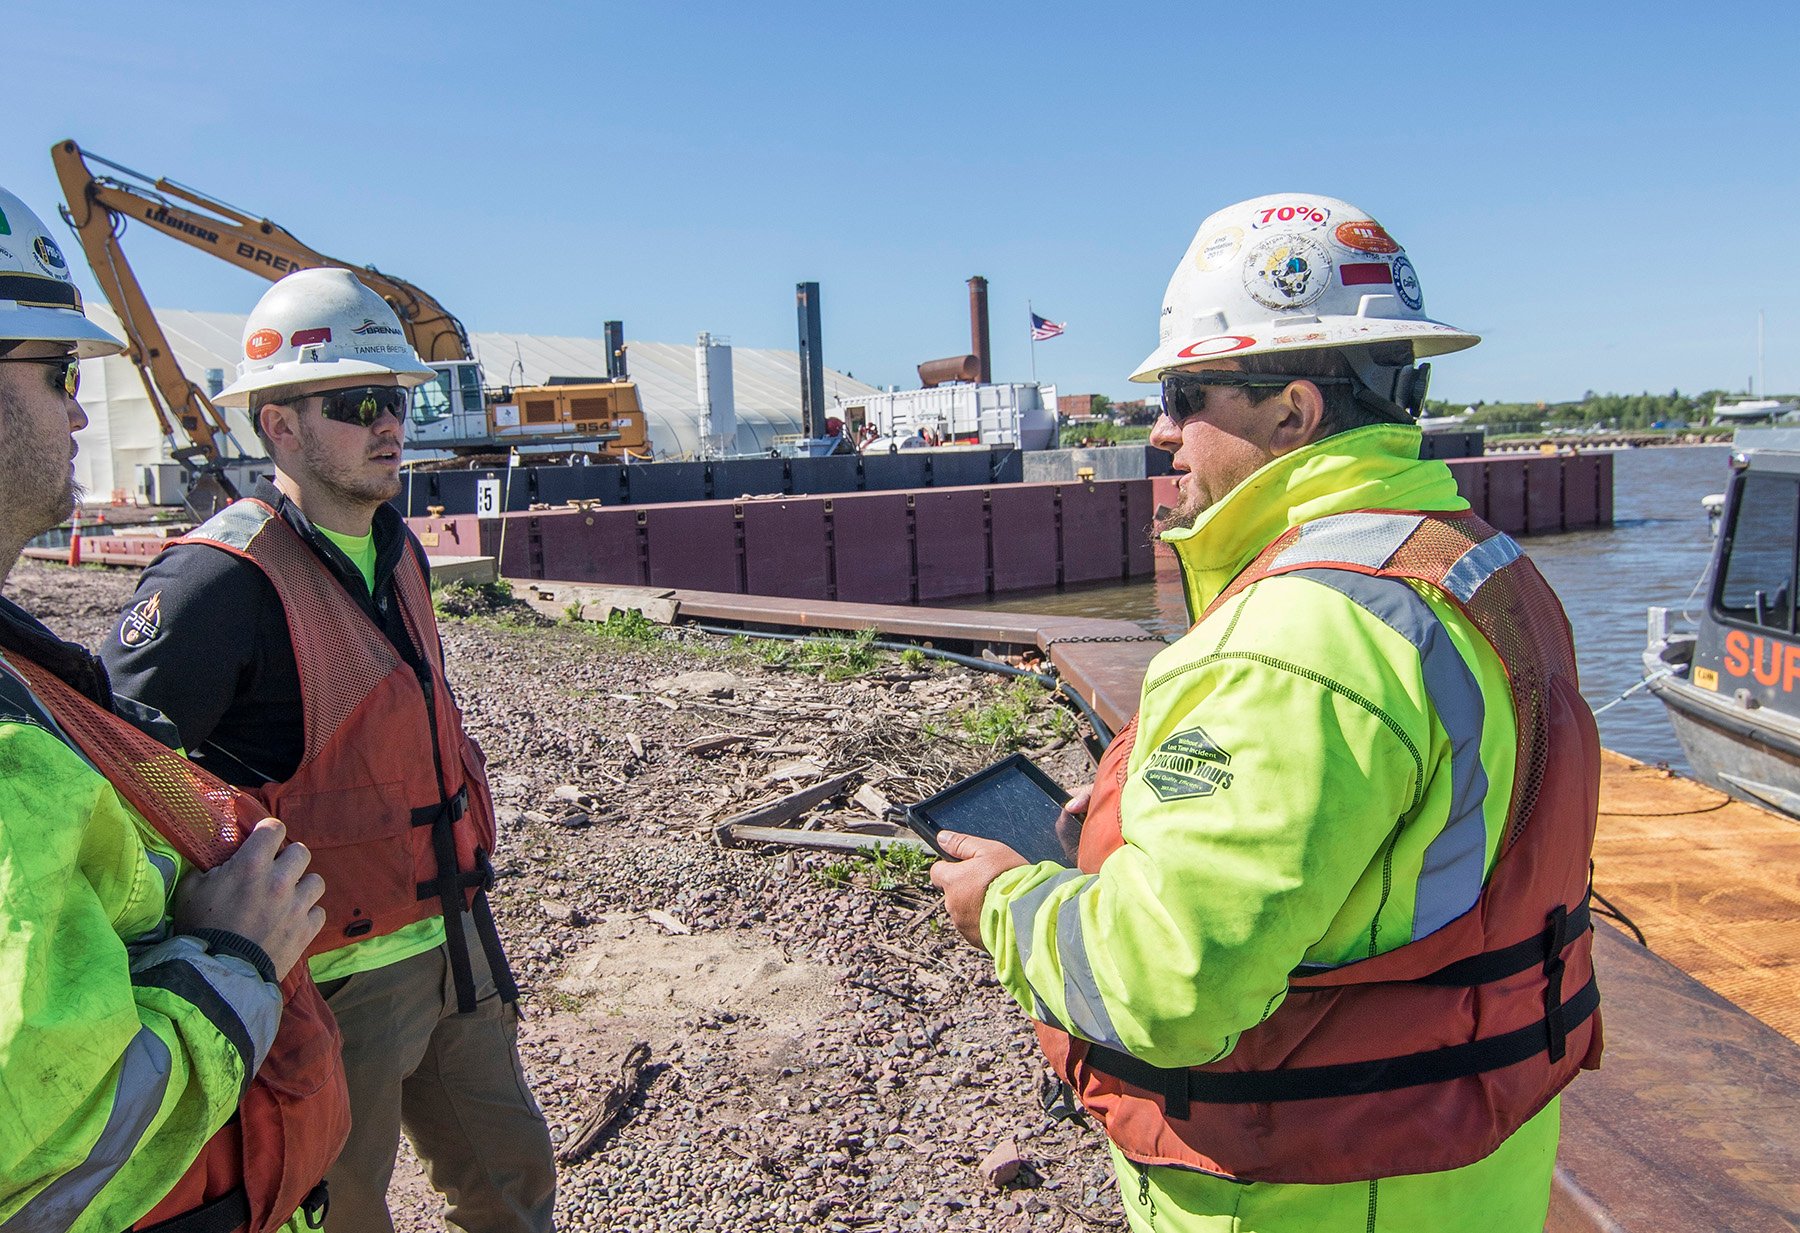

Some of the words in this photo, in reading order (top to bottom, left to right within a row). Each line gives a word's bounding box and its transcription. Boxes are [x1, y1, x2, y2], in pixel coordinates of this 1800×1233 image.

[1260, 206, 1324, 224] 70%
[145, 207, 219, 244] LIEBHERR
[366, 326, 403, 336] BRENNAN
[354, 345, 386, 354] TANNER
[575, 421, 610, 432] 954
[484, 487, 492, 511] 5
[1189, 747, 1217, 759] Incident
